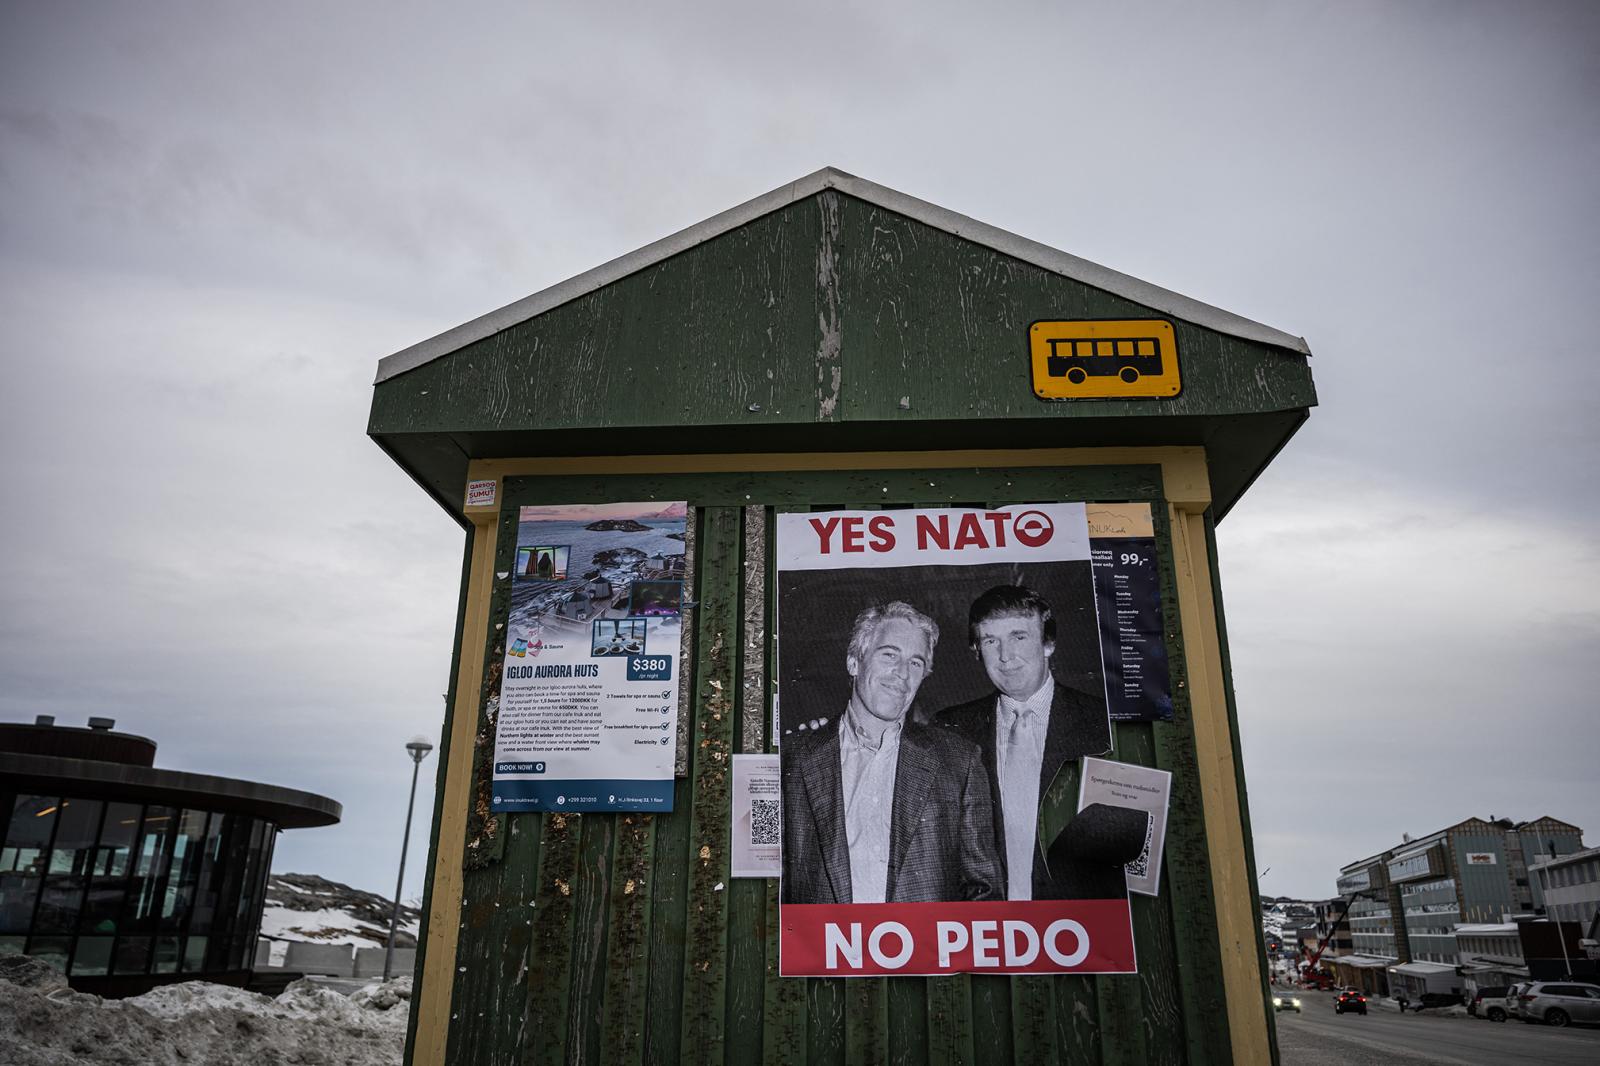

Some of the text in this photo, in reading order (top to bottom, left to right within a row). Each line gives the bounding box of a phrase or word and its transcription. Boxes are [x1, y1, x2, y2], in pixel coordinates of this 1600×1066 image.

[469, 490, 494, 498] SUMUT
[808, 510, 1054, 554] YES NATO
[1121, 553, 1148, 566] 99,-
[507, 664, 598, 679] IGLOO AURORA HUTS
[633, 658, 666, 672] $380
[825, 919, 1090, 969] NO PEDO
